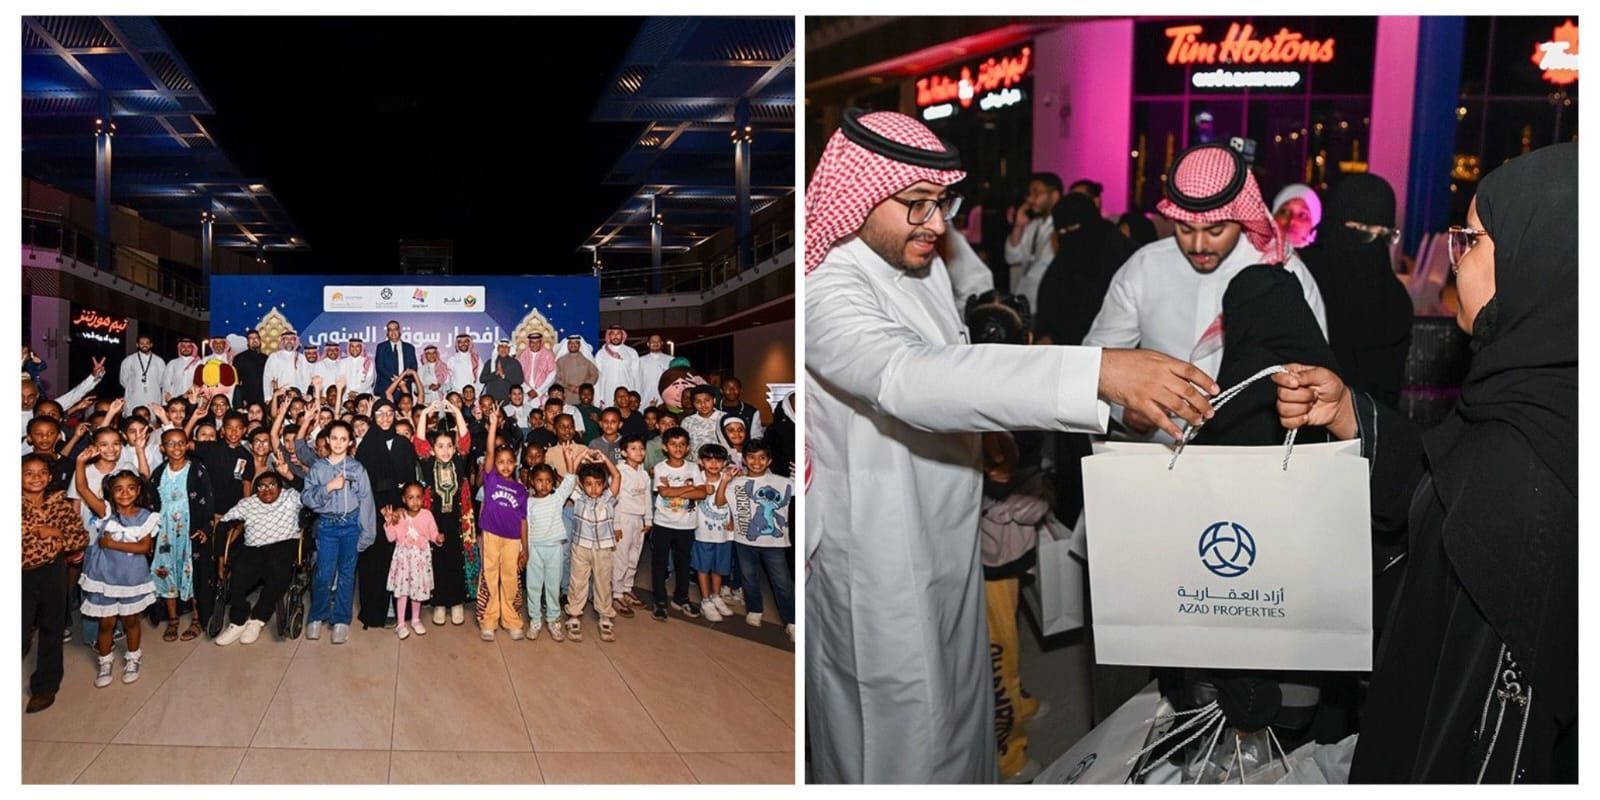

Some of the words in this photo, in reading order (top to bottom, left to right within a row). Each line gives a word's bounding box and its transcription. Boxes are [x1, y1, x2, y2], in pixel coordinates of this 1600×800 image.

[1165, 25, 1217, 64] Tim
[1218, 22, 1336, 64] Hortons
[73, 310, 110, 328] هورتنز
[108, 319, 129, 333] تيم
[1178, 603, 1210, 615] AZAD
[1213, 604, 1286, 618] PROPERTIES
